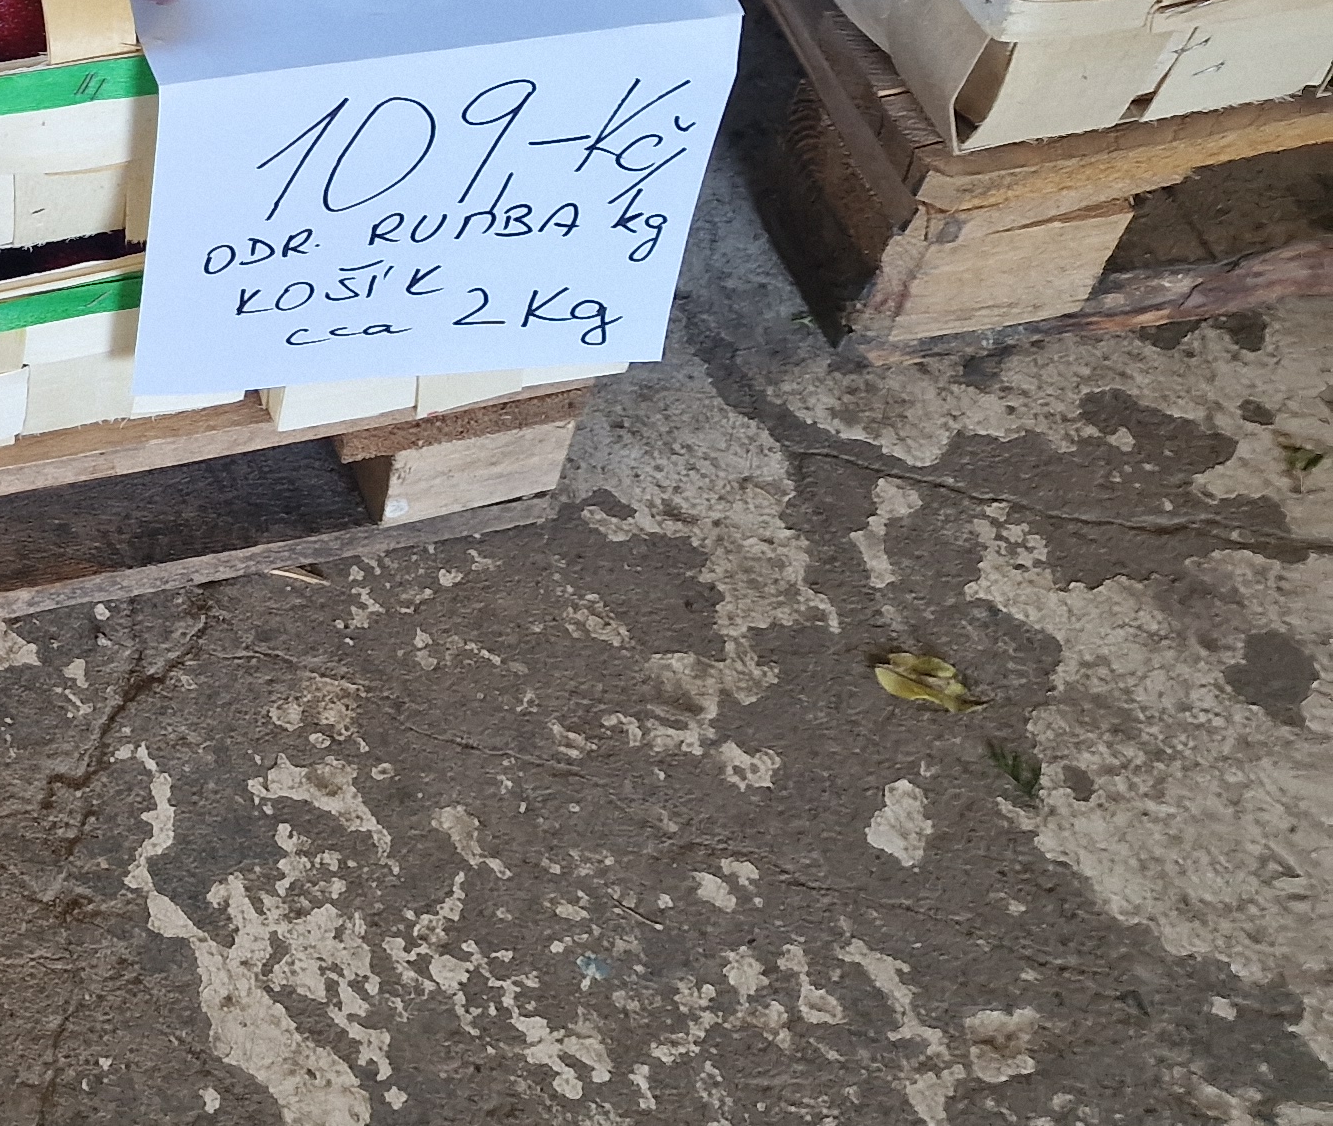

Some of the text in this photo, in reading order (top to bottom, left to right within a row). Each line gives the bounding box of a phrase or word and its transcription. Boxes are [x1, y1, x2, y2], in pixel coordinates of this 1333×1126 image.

[203, 202, 580, 275] ODR. RUMBA
[235, 259, 445, 317] KOŠÍK
[285, 323, 411, 347] cca
